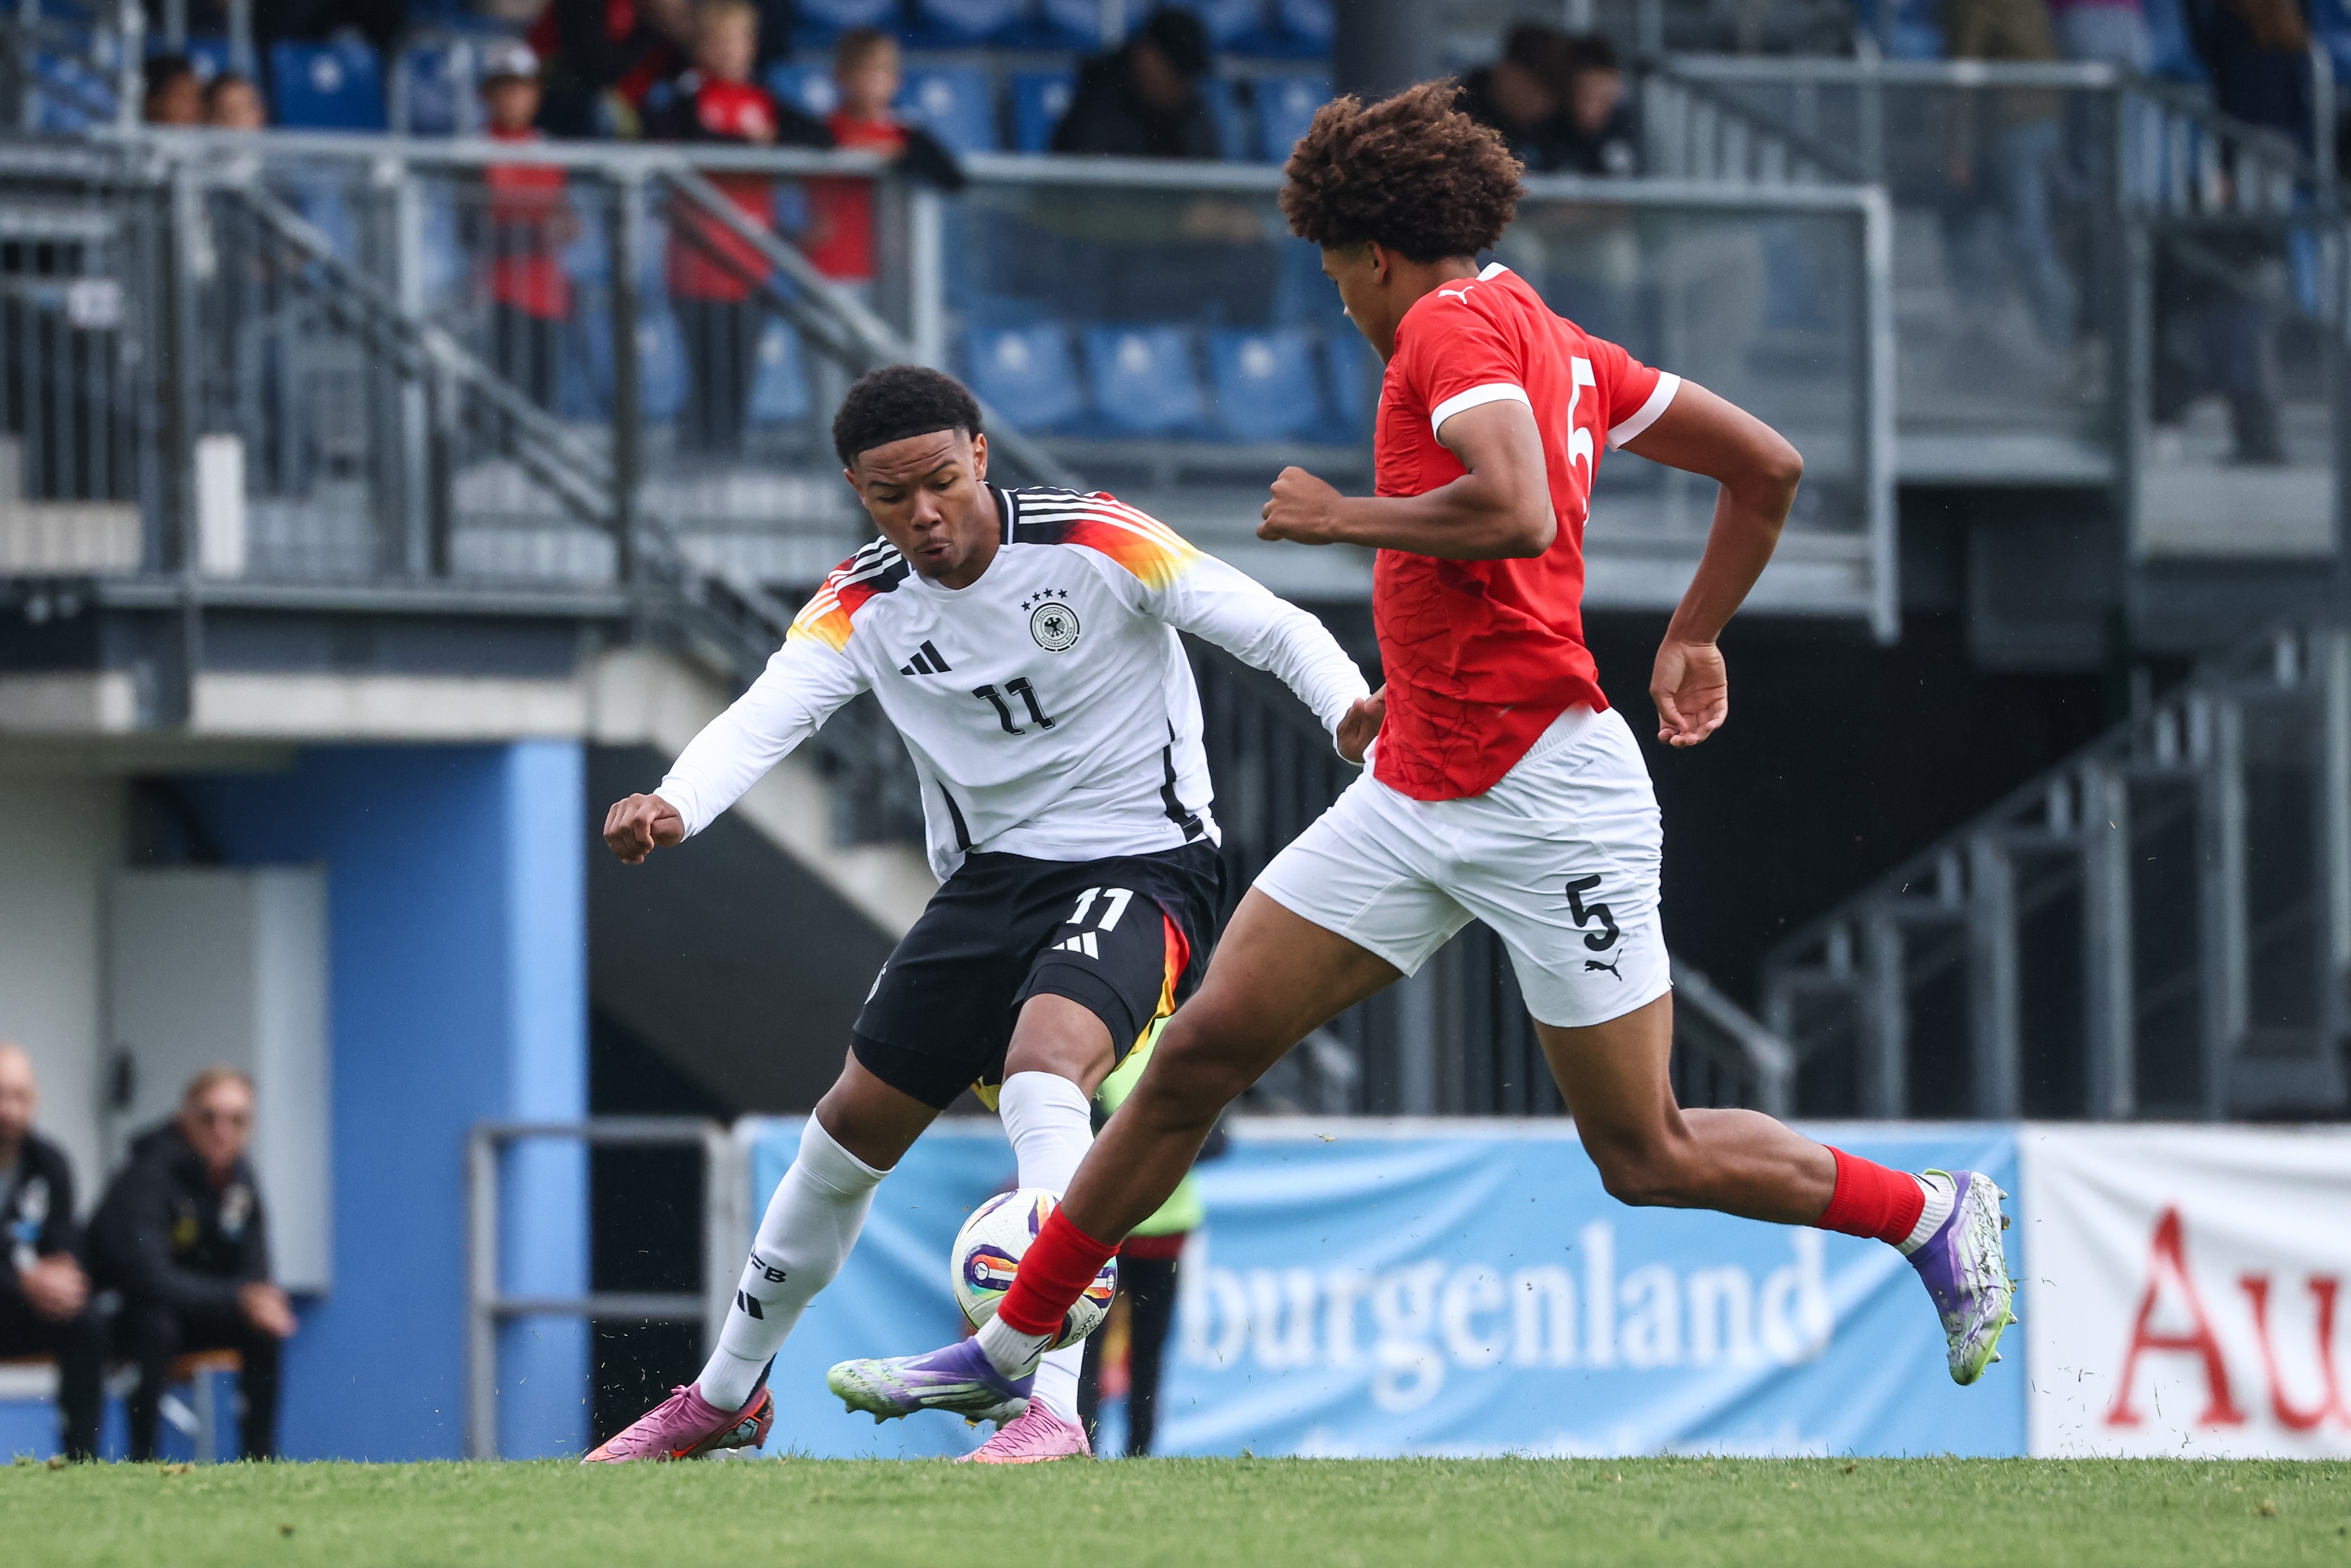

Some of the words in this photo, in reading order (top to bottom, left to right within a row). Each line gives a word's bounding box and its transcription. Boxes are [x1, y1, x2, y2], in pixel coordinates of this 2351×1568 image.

[1567, 355, 1597, 529] 5
[1037, 608, 1063, 622] DEUTSCHER
[971, 676, 1055, 735] 11
[1066, 887, 1134, 932] 11
[1565, 874, 1620, 952] 5
[751, 1251, 787, 1283] FB
[1178, 1221, 1832, 1413] burgenland
